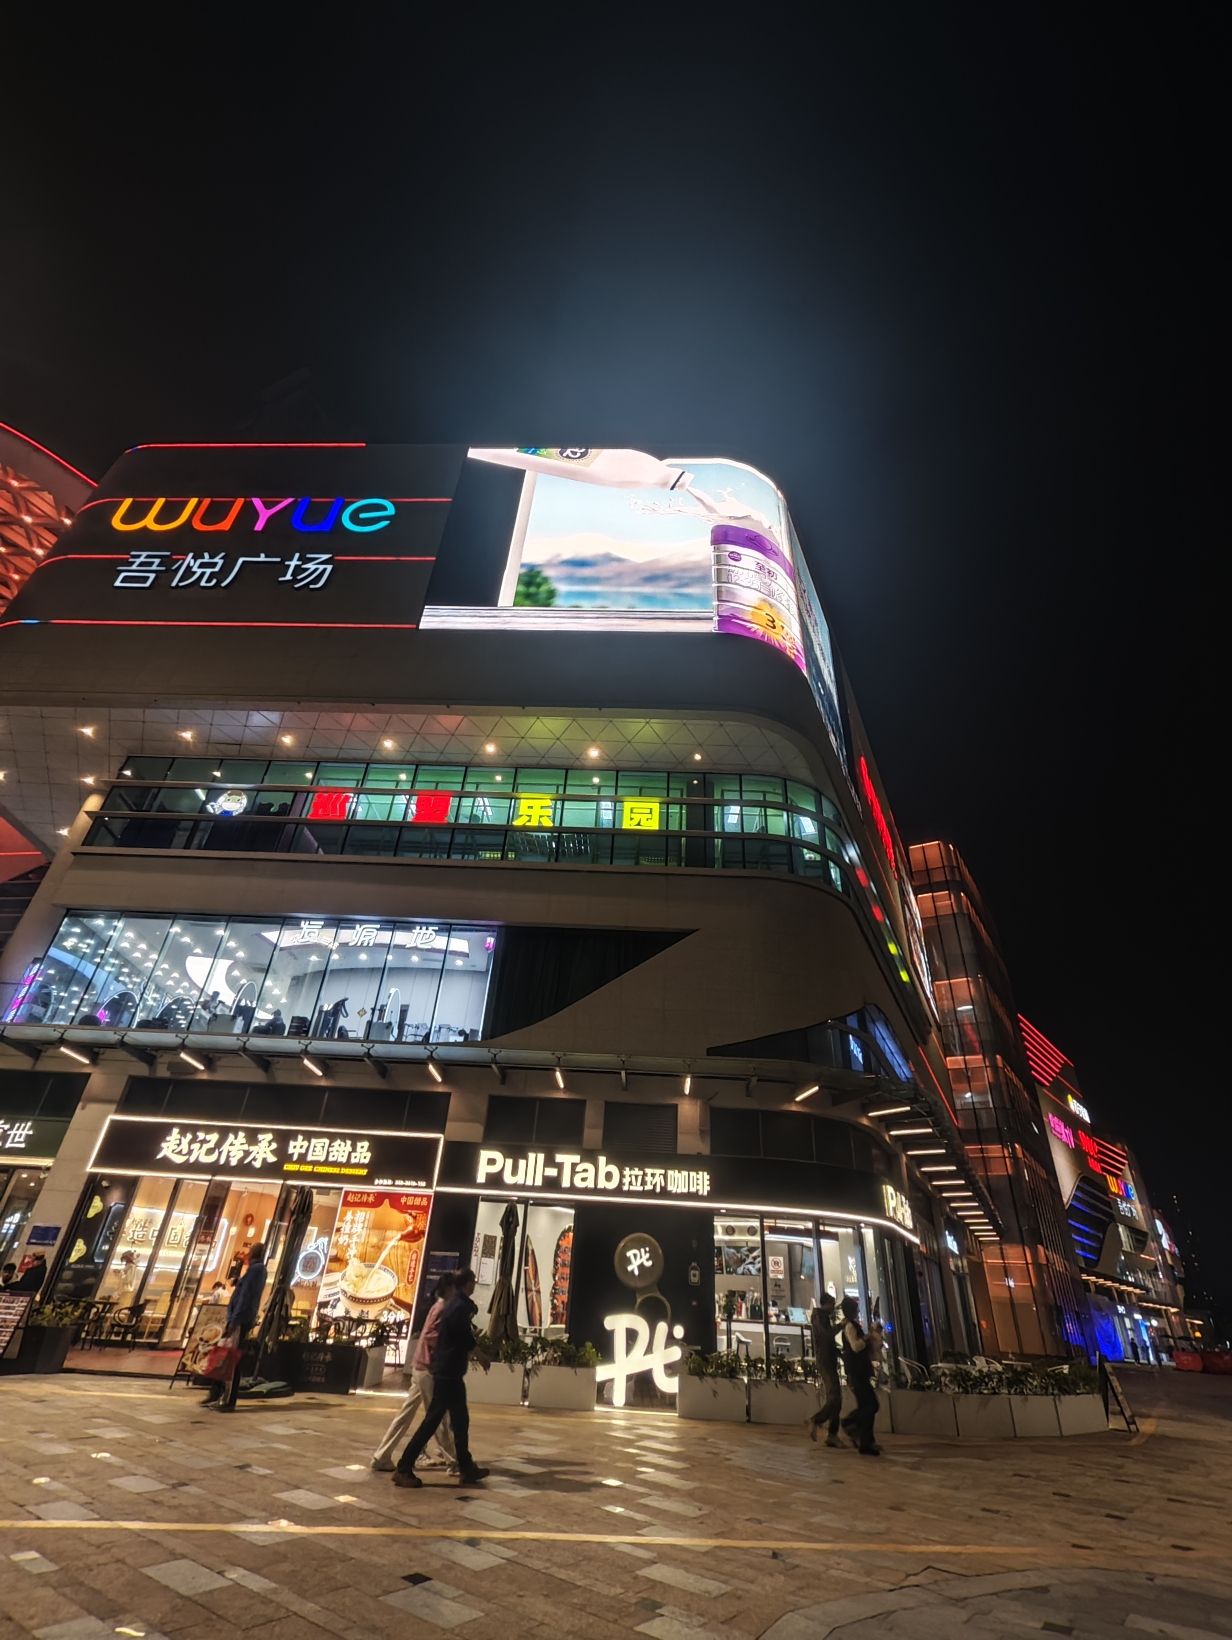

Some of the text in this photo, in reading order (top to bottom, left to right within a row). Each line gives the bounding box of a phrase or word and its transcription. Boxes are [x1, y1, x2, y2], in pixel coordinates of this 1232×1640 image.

[113, 551, 334, 590] 吾悦广场
[156, 1127, 372, 1168] 赵记传承 中国甜品
[476, 1150, 710, 1196] Pull-Tab 拉环咖啡
